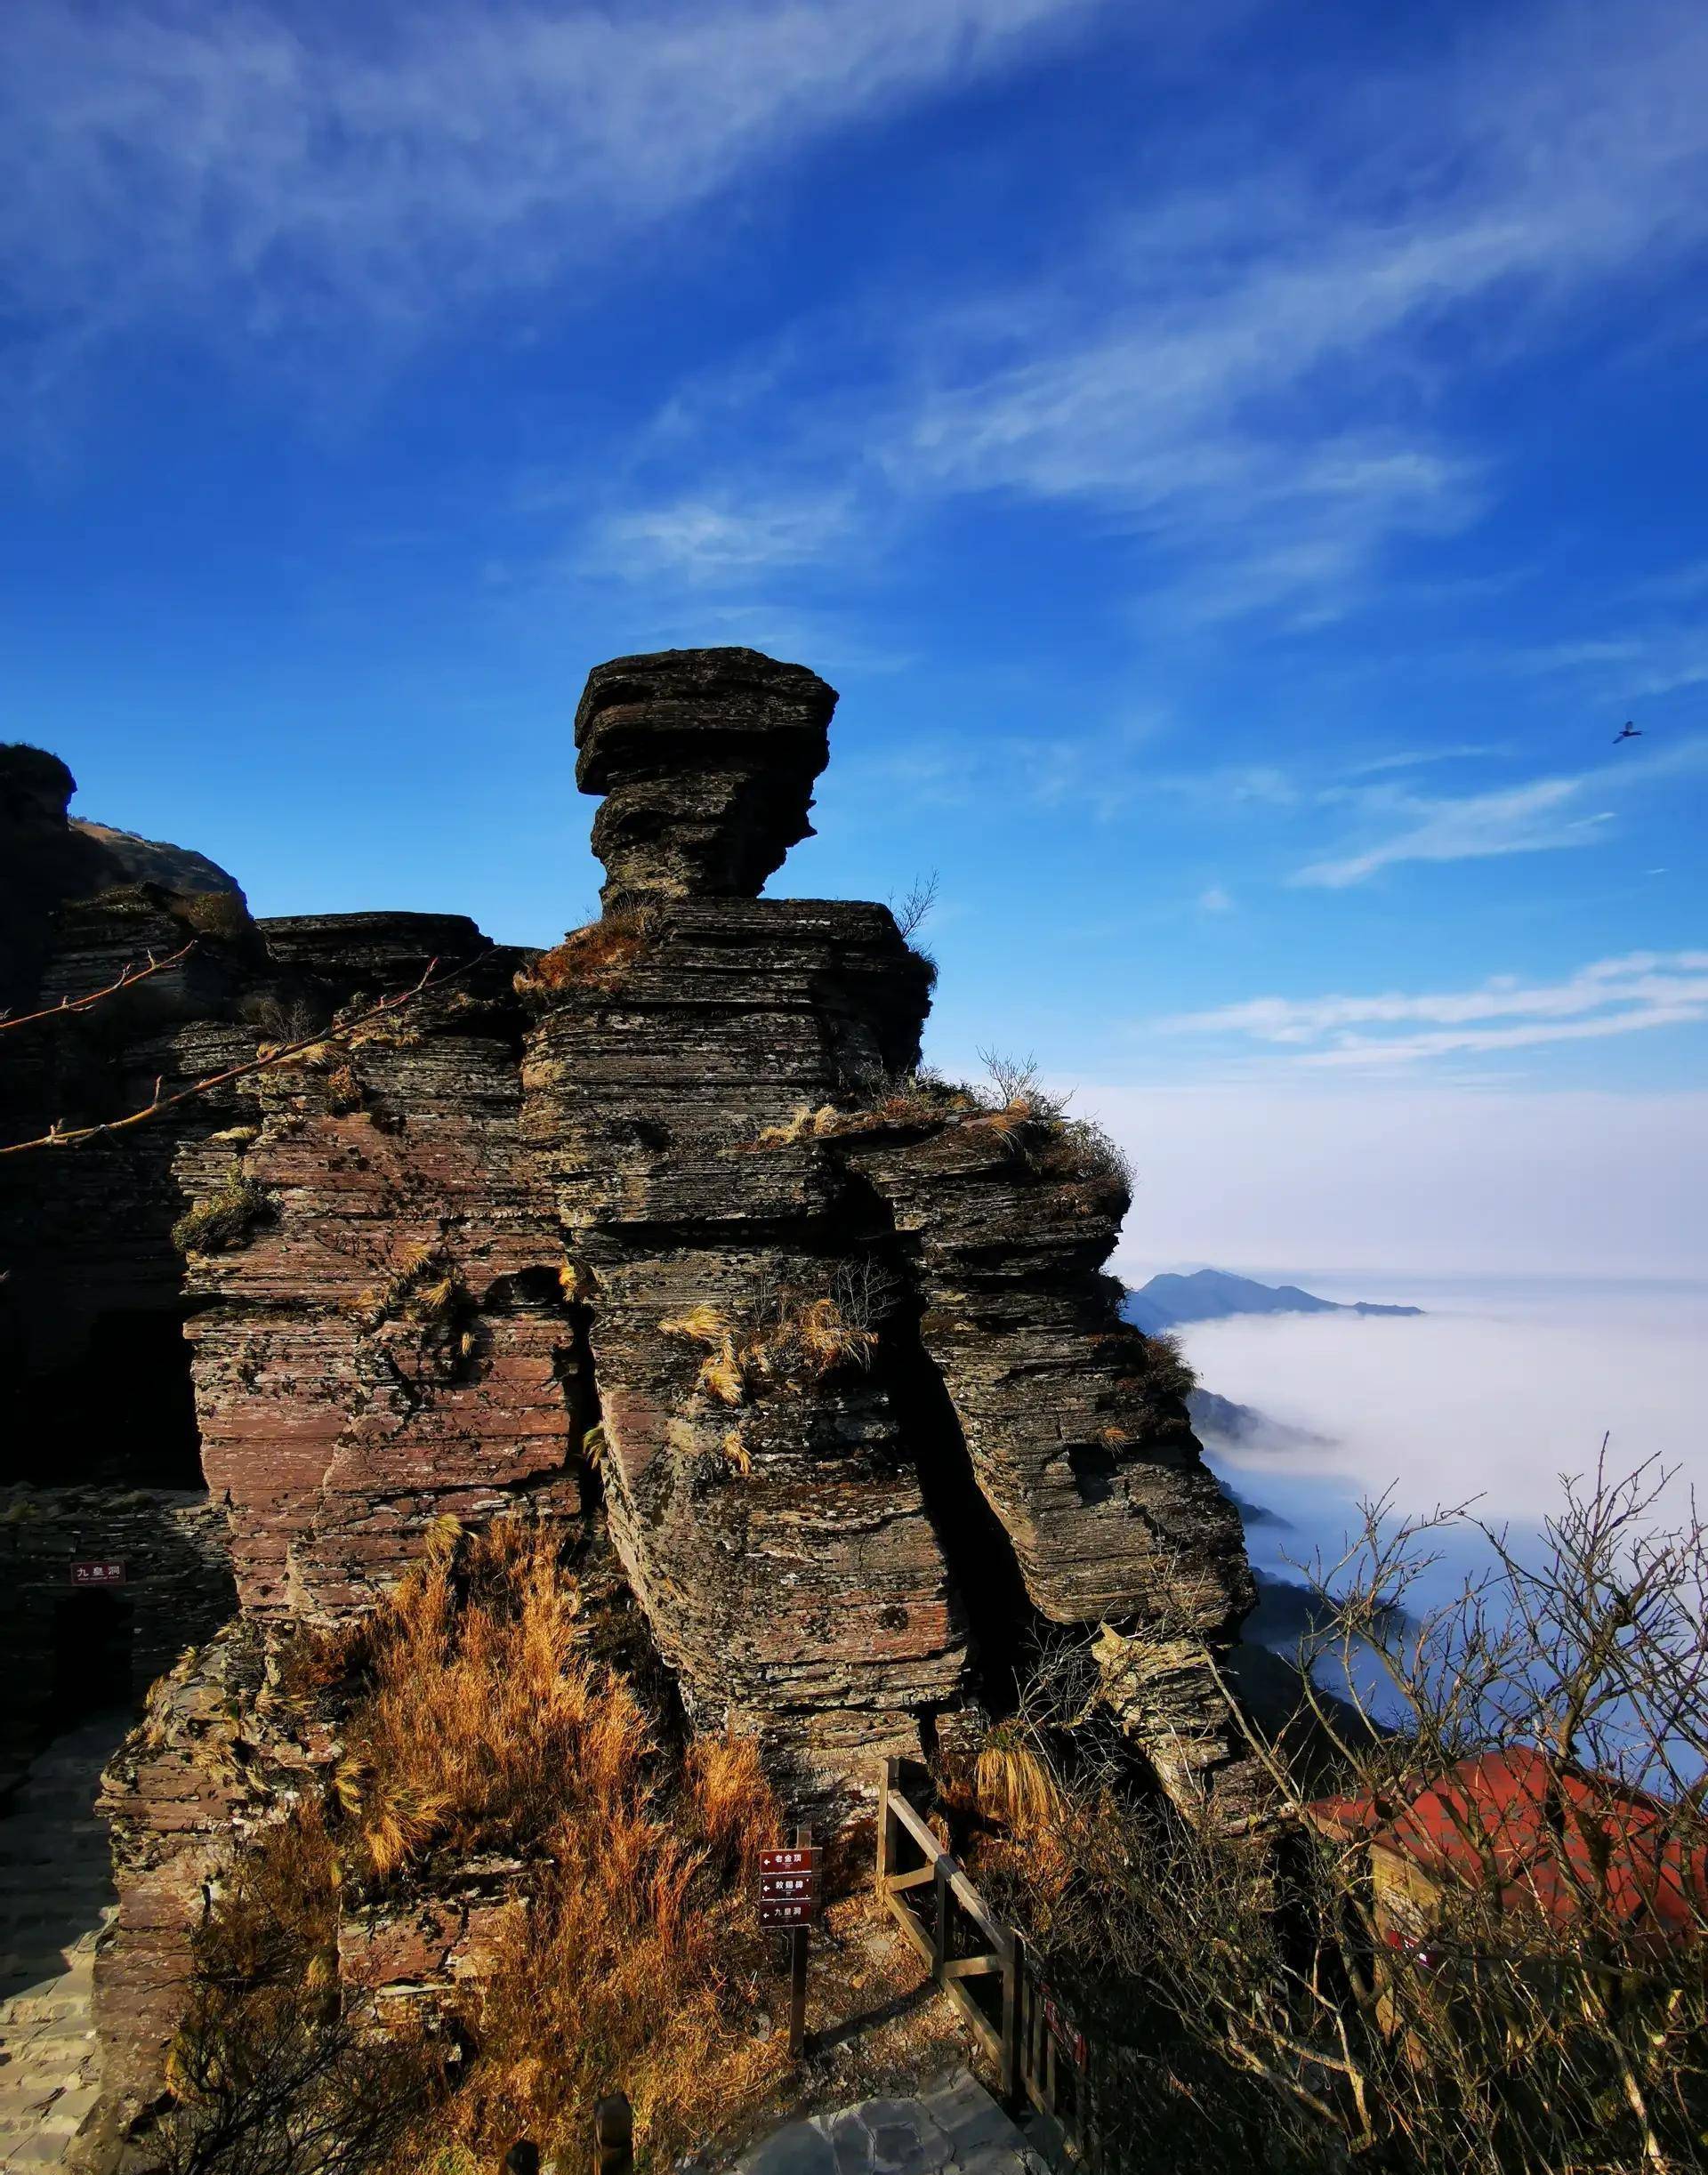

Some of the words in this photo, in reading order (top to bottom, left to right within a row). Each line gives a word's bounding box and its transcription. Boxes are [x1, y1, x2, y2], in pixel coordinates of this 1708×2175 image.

[77, 1566, 120, 1577] 九皇洞
[775, 1854, 802, 1863] 老金顶
[774, 1906, 802, 1916] 九皇洞
